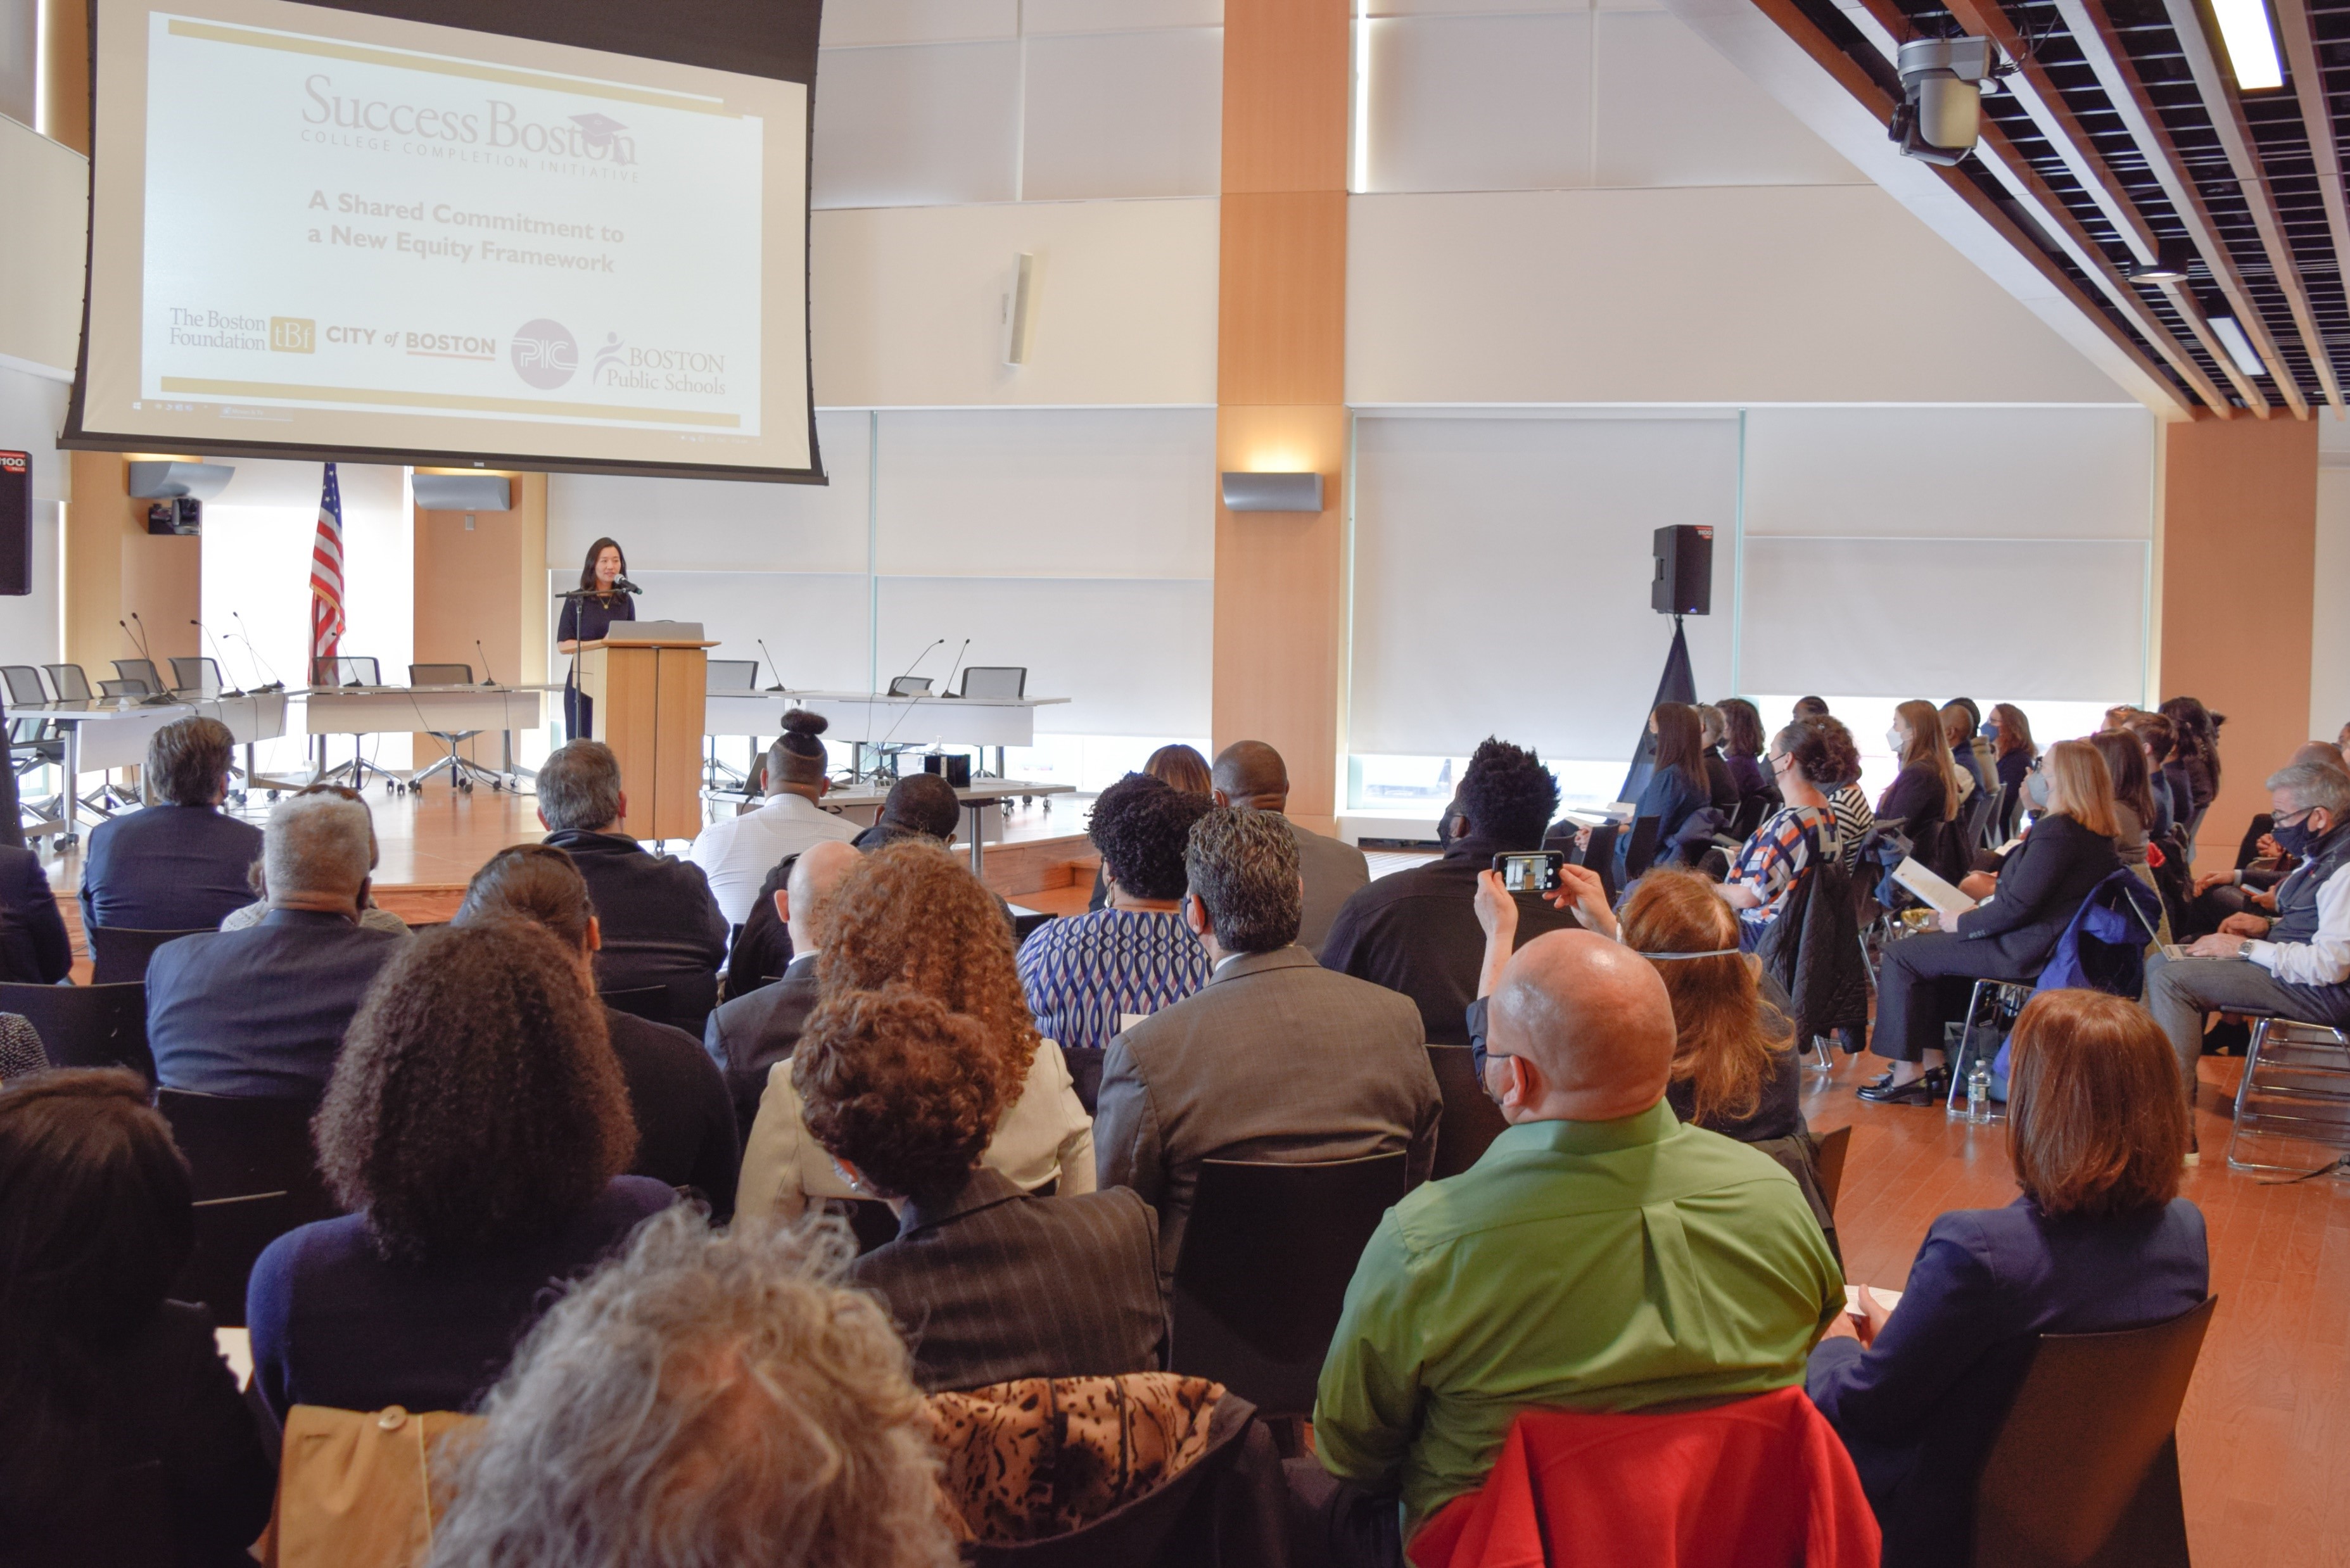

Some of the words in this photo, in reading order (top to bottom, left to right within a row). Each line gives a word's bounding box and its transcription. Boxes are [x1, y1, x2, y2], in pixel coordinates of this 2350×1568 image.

[302, 74, 478, 144] Success
[486, 99, 638, 166] Boston
[302, 129, 391, 151] COLLEGE
[403, 142, 529, 169] COMPLETION
[541, 161, 639, 184] INITIATIVE
[308, 190, 329, 211] A
[338, 193, 424, 221] Shared
[433, 204, 594, 240] Commitment
[600, 225, 624, 243] to
[308, 227, 322, 243] a
[331, 225, 387, 250] New
[397, 232, 473, 263] Equity
[481, 241, 614, 274] Framework
[170, 307, 204, 328] The
[207, 310, 266, 332] Boston
[170, 327, 266, 351] Foundation
[274, 322, 312, 349] tBf
[326, 326, 377, 345] CITY
[384, 331, 400, 348] of
[406, 332, 496, 355] BOSTON
[511, 337, 578, 371] PIC
[630, 347, 726, 374] BOSTON
[606, 369, 659, 390] Public
[664, 373, 726, 396] Schools
